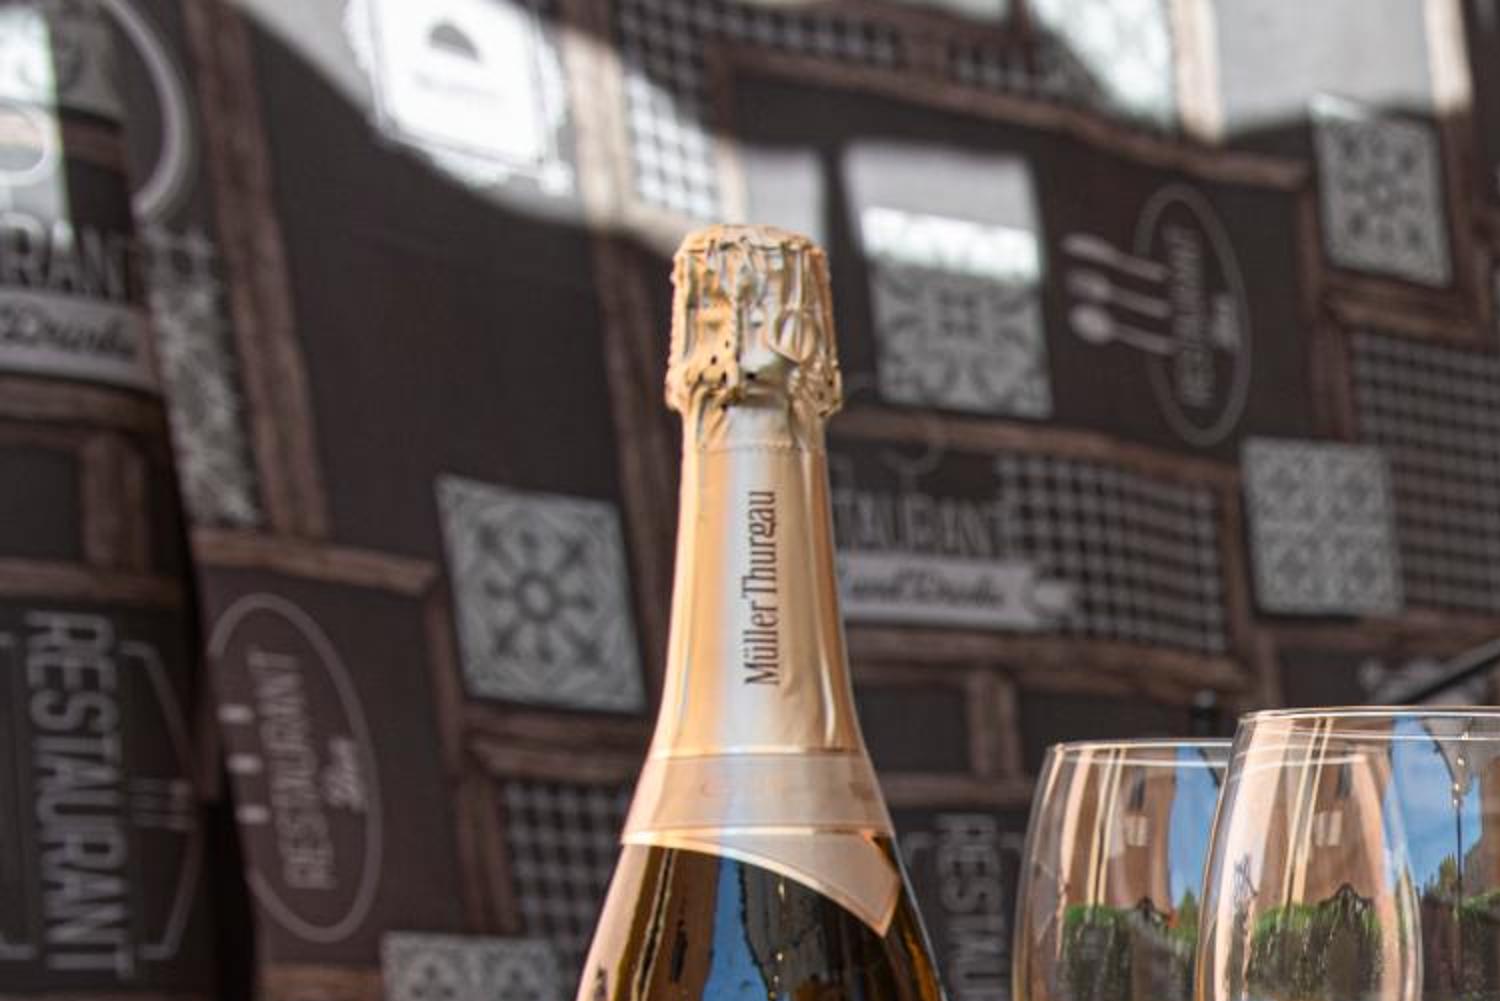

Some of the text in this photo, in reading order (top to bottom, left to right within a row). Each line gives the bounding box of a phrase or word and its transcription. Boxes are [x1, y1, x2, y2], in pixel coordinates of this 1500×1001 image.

[740, 490, 779, 686] Müller Thurgau
[26, 609, 136, 980] RESTAURANT
[246, 642, 338, 892] RESTAURANT
